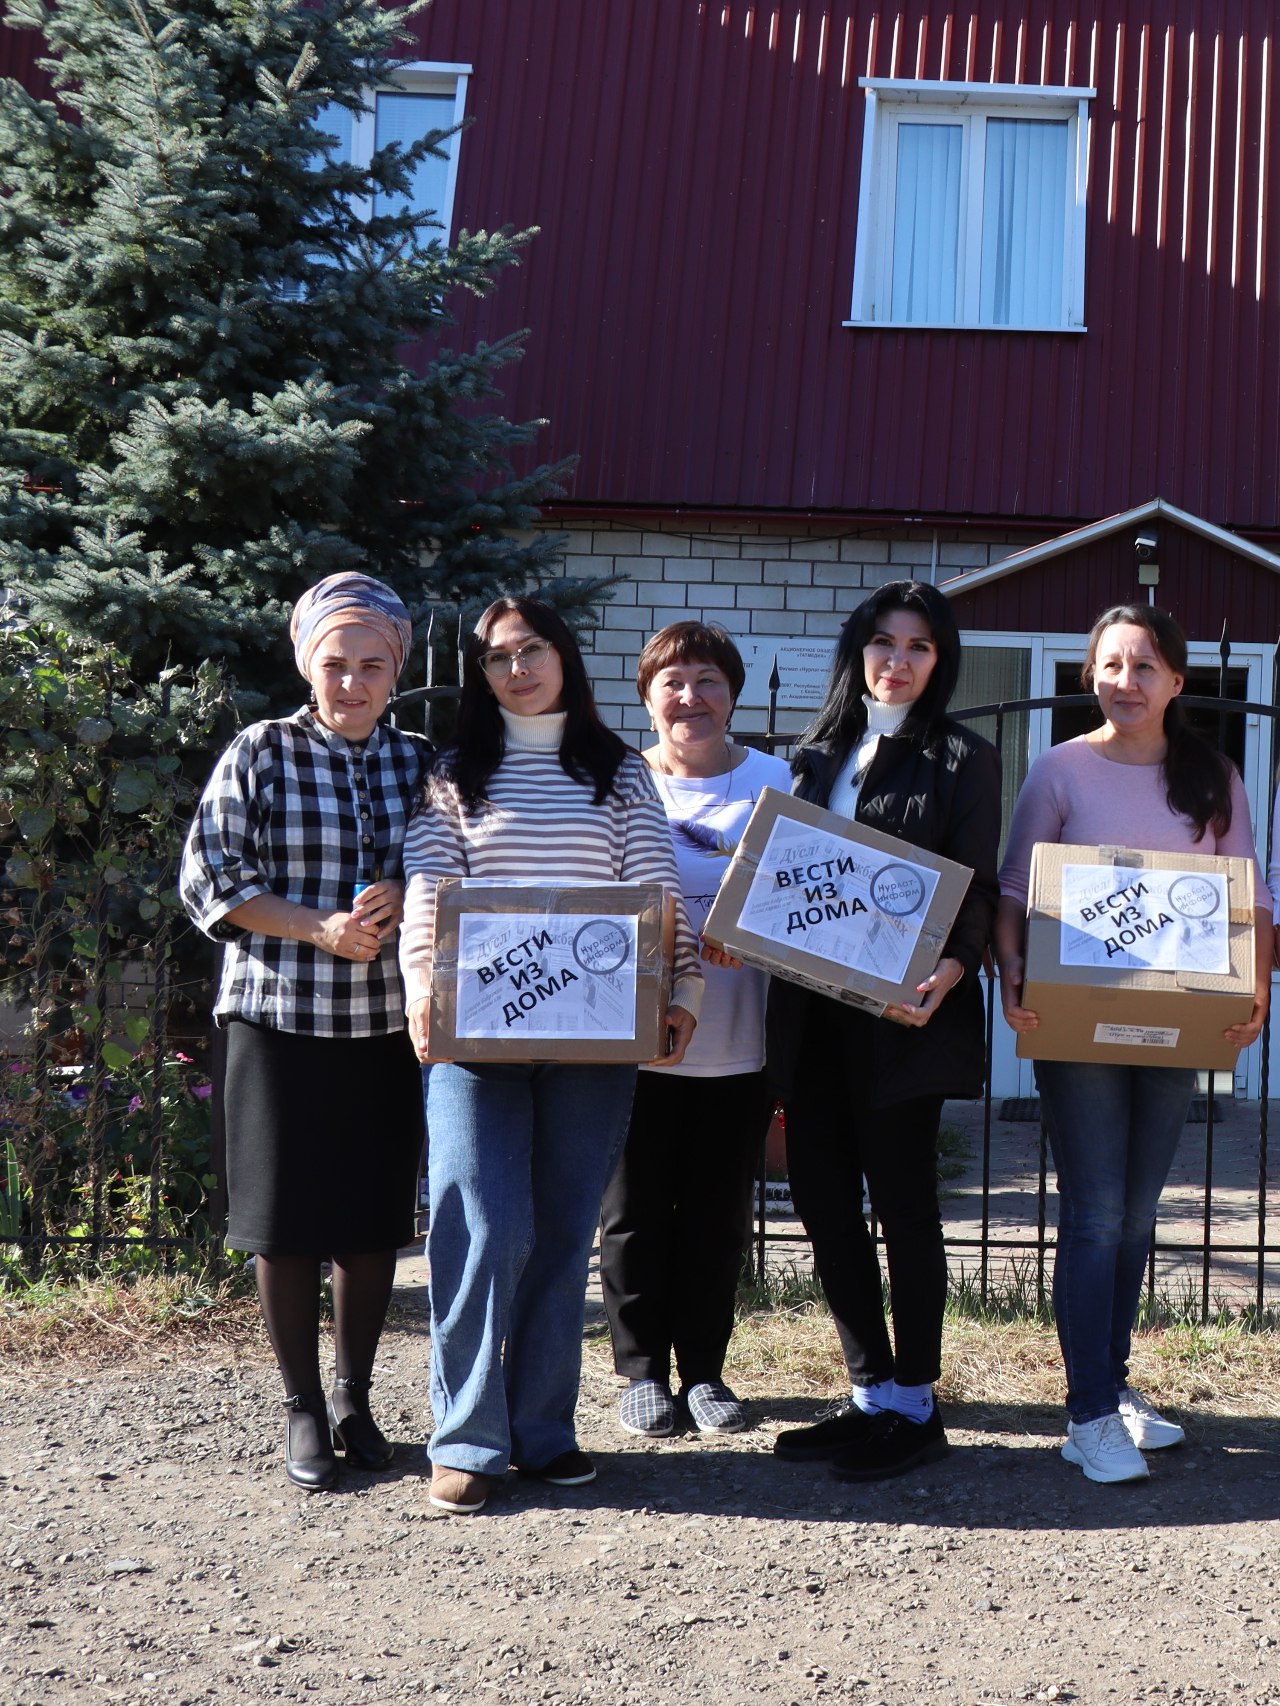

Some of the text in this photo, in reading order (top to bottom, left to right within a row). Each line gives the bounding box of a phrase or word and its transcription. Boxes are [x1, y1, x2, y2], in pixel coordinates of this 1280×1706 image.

[776, 856, 855, 888] ВЕСТИ
[804, 882, 838, 904] ИЗ
[1080, 882, 1149, 922] ВЕСТИ
[786, 897, 868, 934] ДОМА
[1110, 905, 1142, 928] ИЗ
[1103, 912, 1175, 958] ДОМА
[477, 929, 553, 986] ВЕСТИ
[510, 961, 544, 991] ИЗ
[502, 968, 579, 1027] ДОМА
